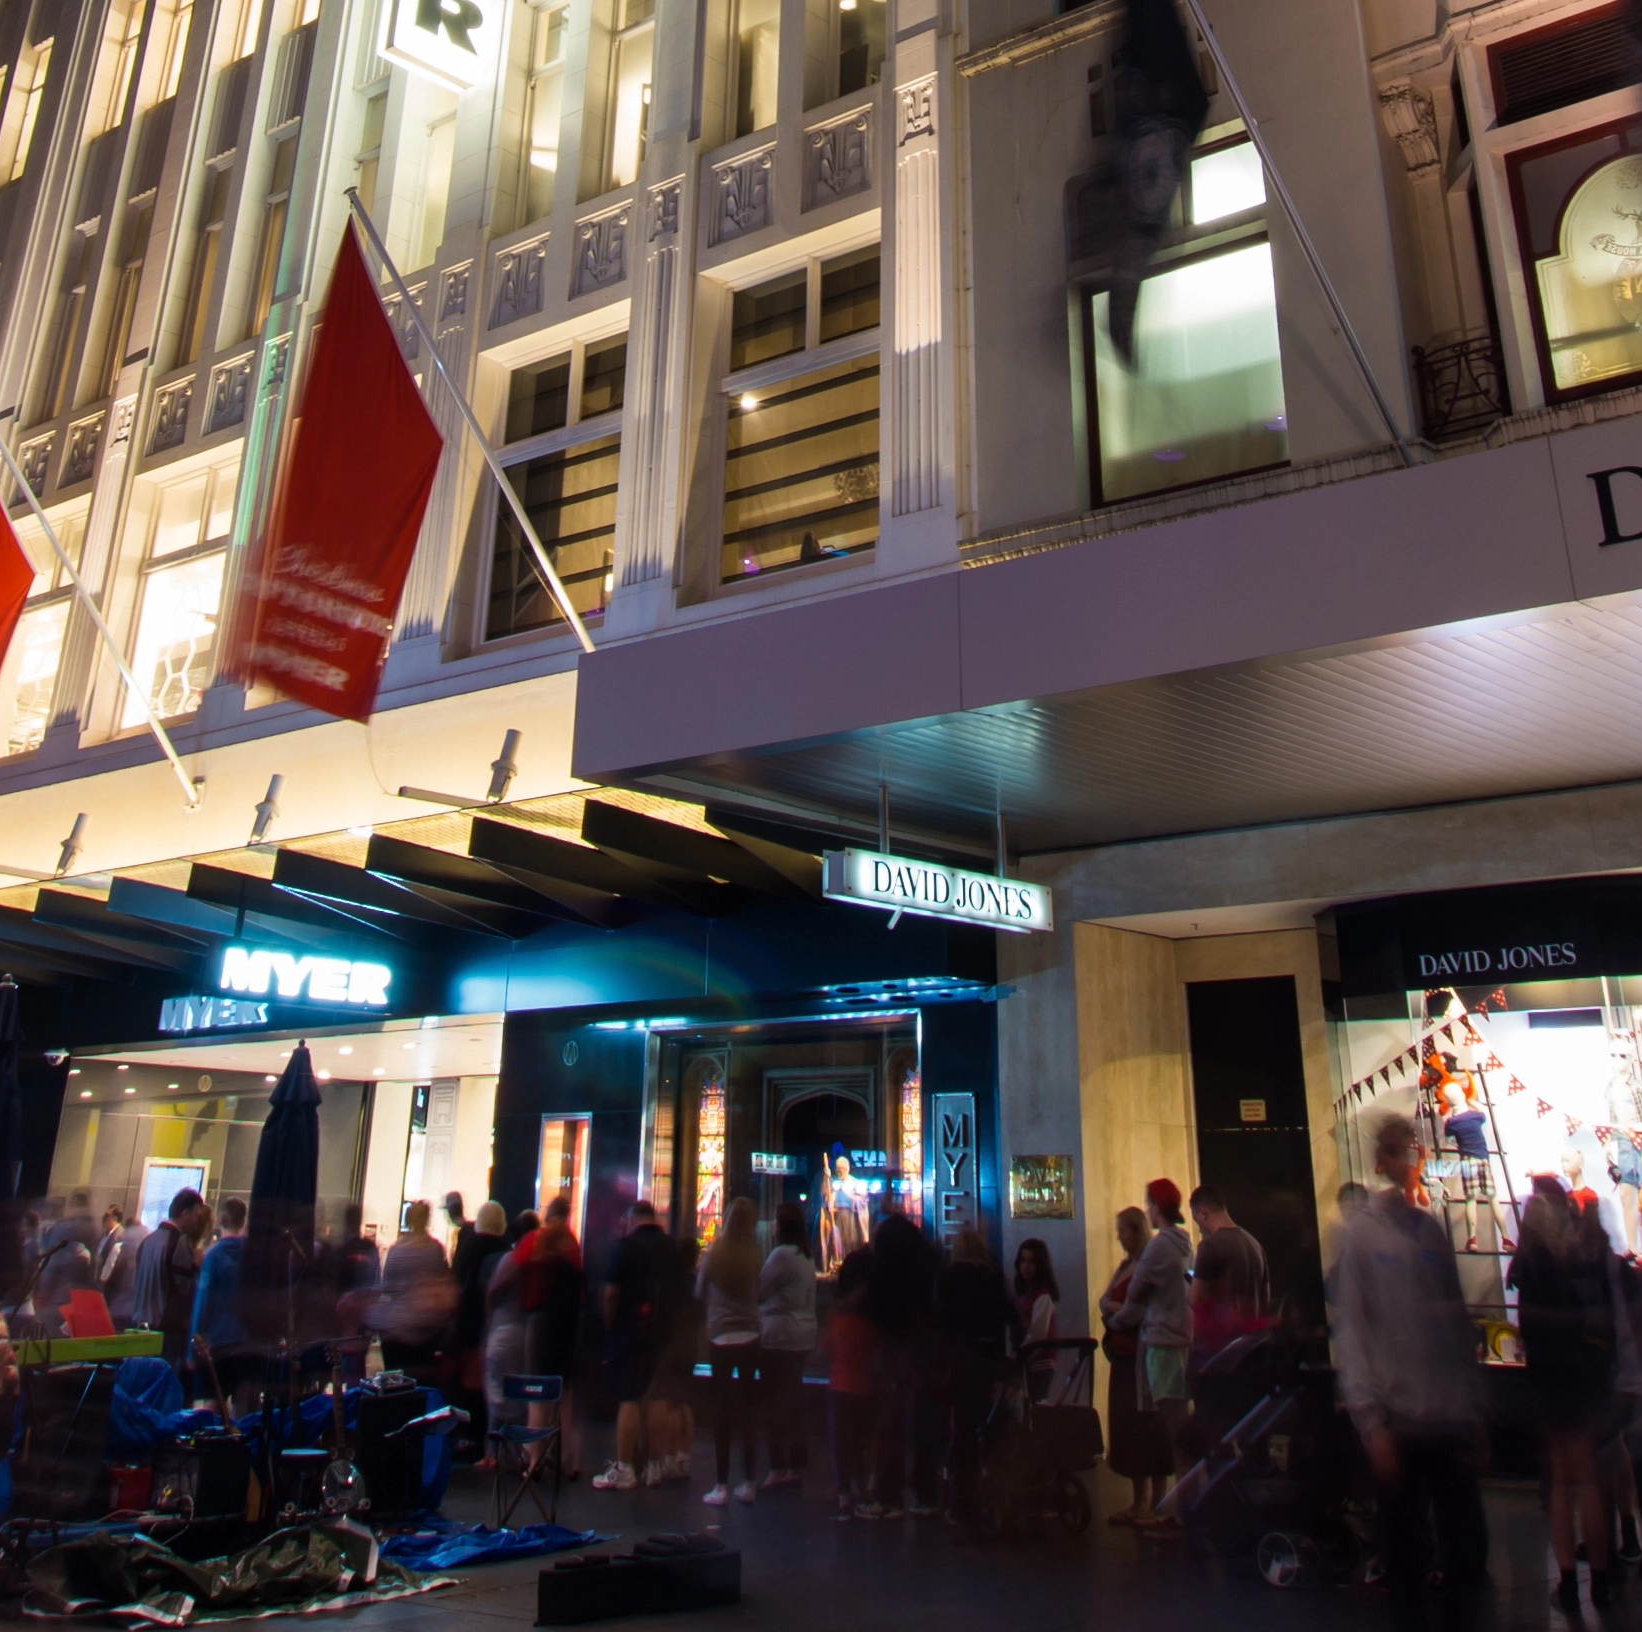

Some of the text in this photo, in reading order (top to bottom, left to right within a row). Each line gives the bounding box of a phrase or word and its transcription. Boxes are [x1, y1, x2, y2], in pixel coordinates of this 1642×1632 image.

[873, 860, 1033, 920] DAVID JONES
[219, 947, 392, 1005] MYER
[1419, 942, 1577, 976] DAVID JONES
